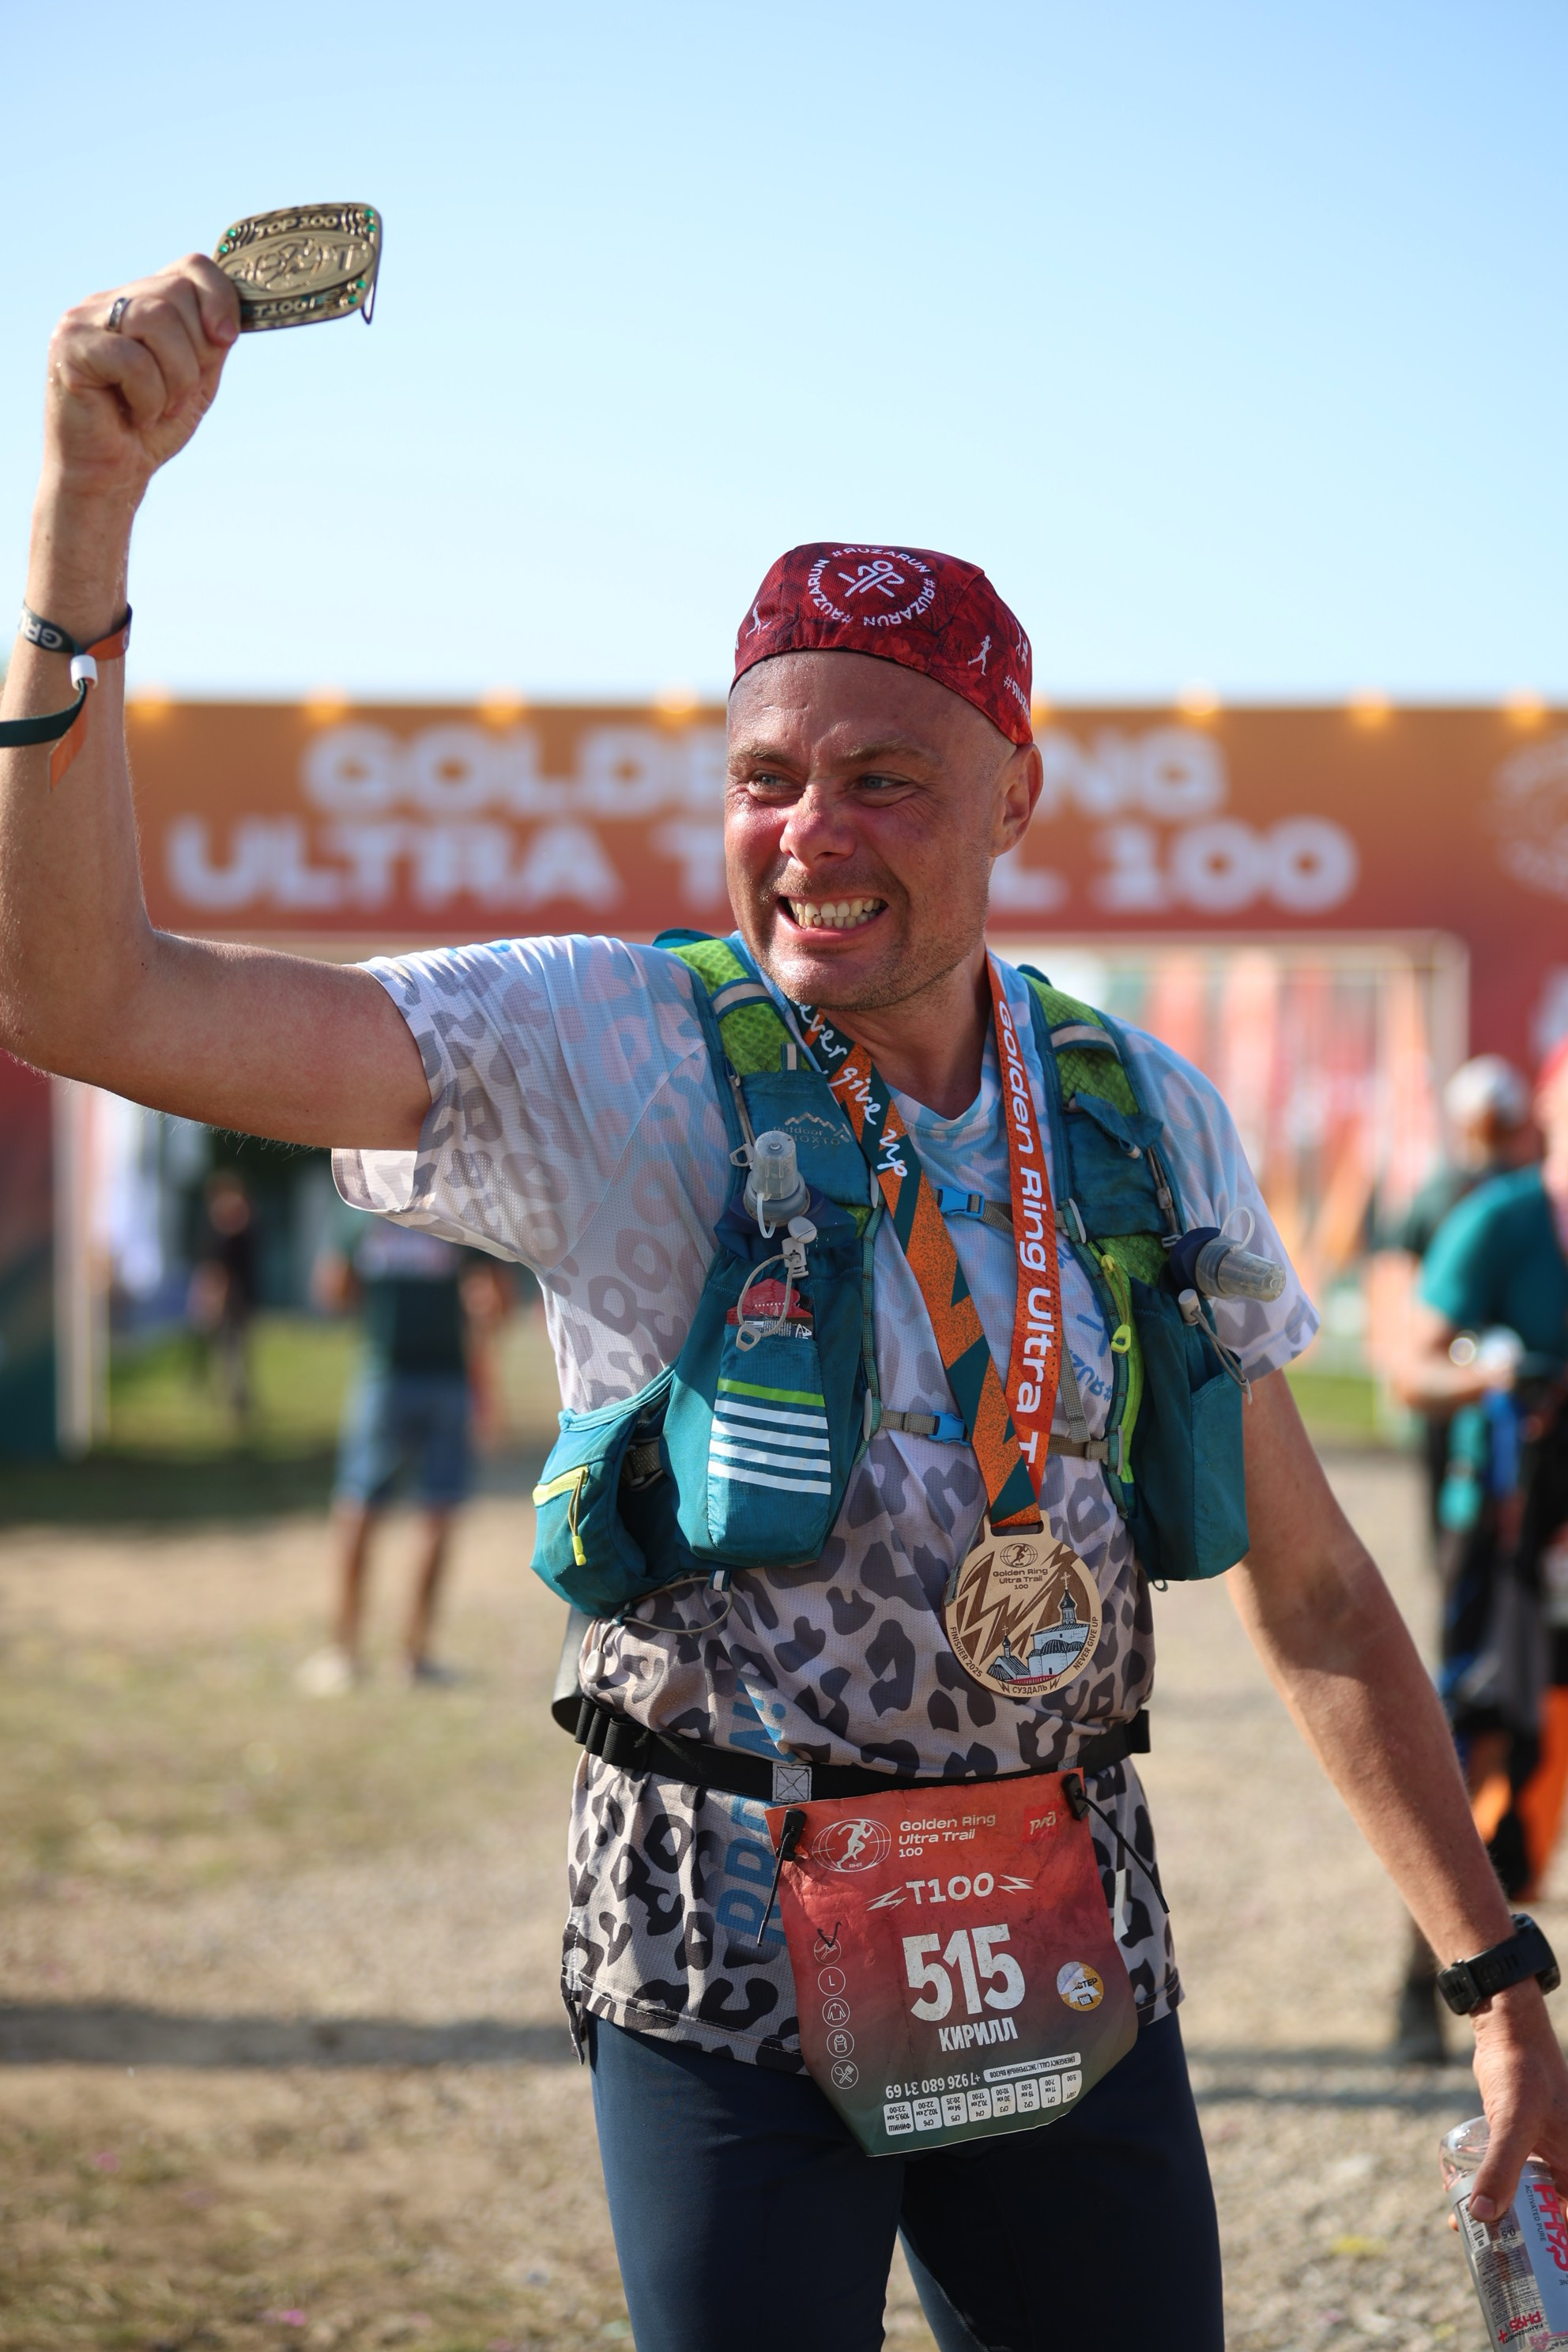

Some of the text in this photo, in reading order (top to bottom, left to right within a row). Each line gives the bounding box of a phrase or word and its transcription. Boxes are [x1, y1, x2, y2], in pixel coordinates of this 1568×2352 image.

[254, 214, 338, 238] TOP 100
[168, 813, 623, 913] ULTRA
[1089, 817, 1358, 914] 100
[797, 1004, 848, 1058] ever
[999, 1000, 1035, 1155] Golden
[824, 1066, 882, 1126] give
[877, 1129, 908, 1178] up
[1020, 1167, 1046, 1272] Ring
[1016, 1287, 1055, 1413] Ultra
[950, 1626, 983, 1677] FINISHER 2025
[1073, 1617, 1099, 1671] NEVER GIVE UP
[1012, 1685, 1048, 1695] СУЗДАЛЬ
[899, 1814, 996, 1831] Golden Ring
[899, 1829, 975, 1845] Ultra Trail
[899, 1847, 923, 1857] 100
[906, 1872, 994, 1905] T100
[829, 1975, 835, 1986] L
[903, 1923, 1026, 2021] 515
[938, 2017, 1018, 2052] КИРИЛЛ
[989, 2070, 1006, 2079] ВЫЗОВ
[1007, 2064, 1037, 2076] ЭКСТРЕННЫЙ
[1050, 2056, 1076, 2067] EMERGENCY
[885, 2072, 981, 2099] +7 926 680 31 69
[971, 2092, 985, 2101] 17:00
[889, 2123, 911, 2132] ФИНИШ
[1525, 2184, 1547, 2242] ACTIVATED PURE
[1505, 2323, 1544, 2343] FAHRENHEIT
